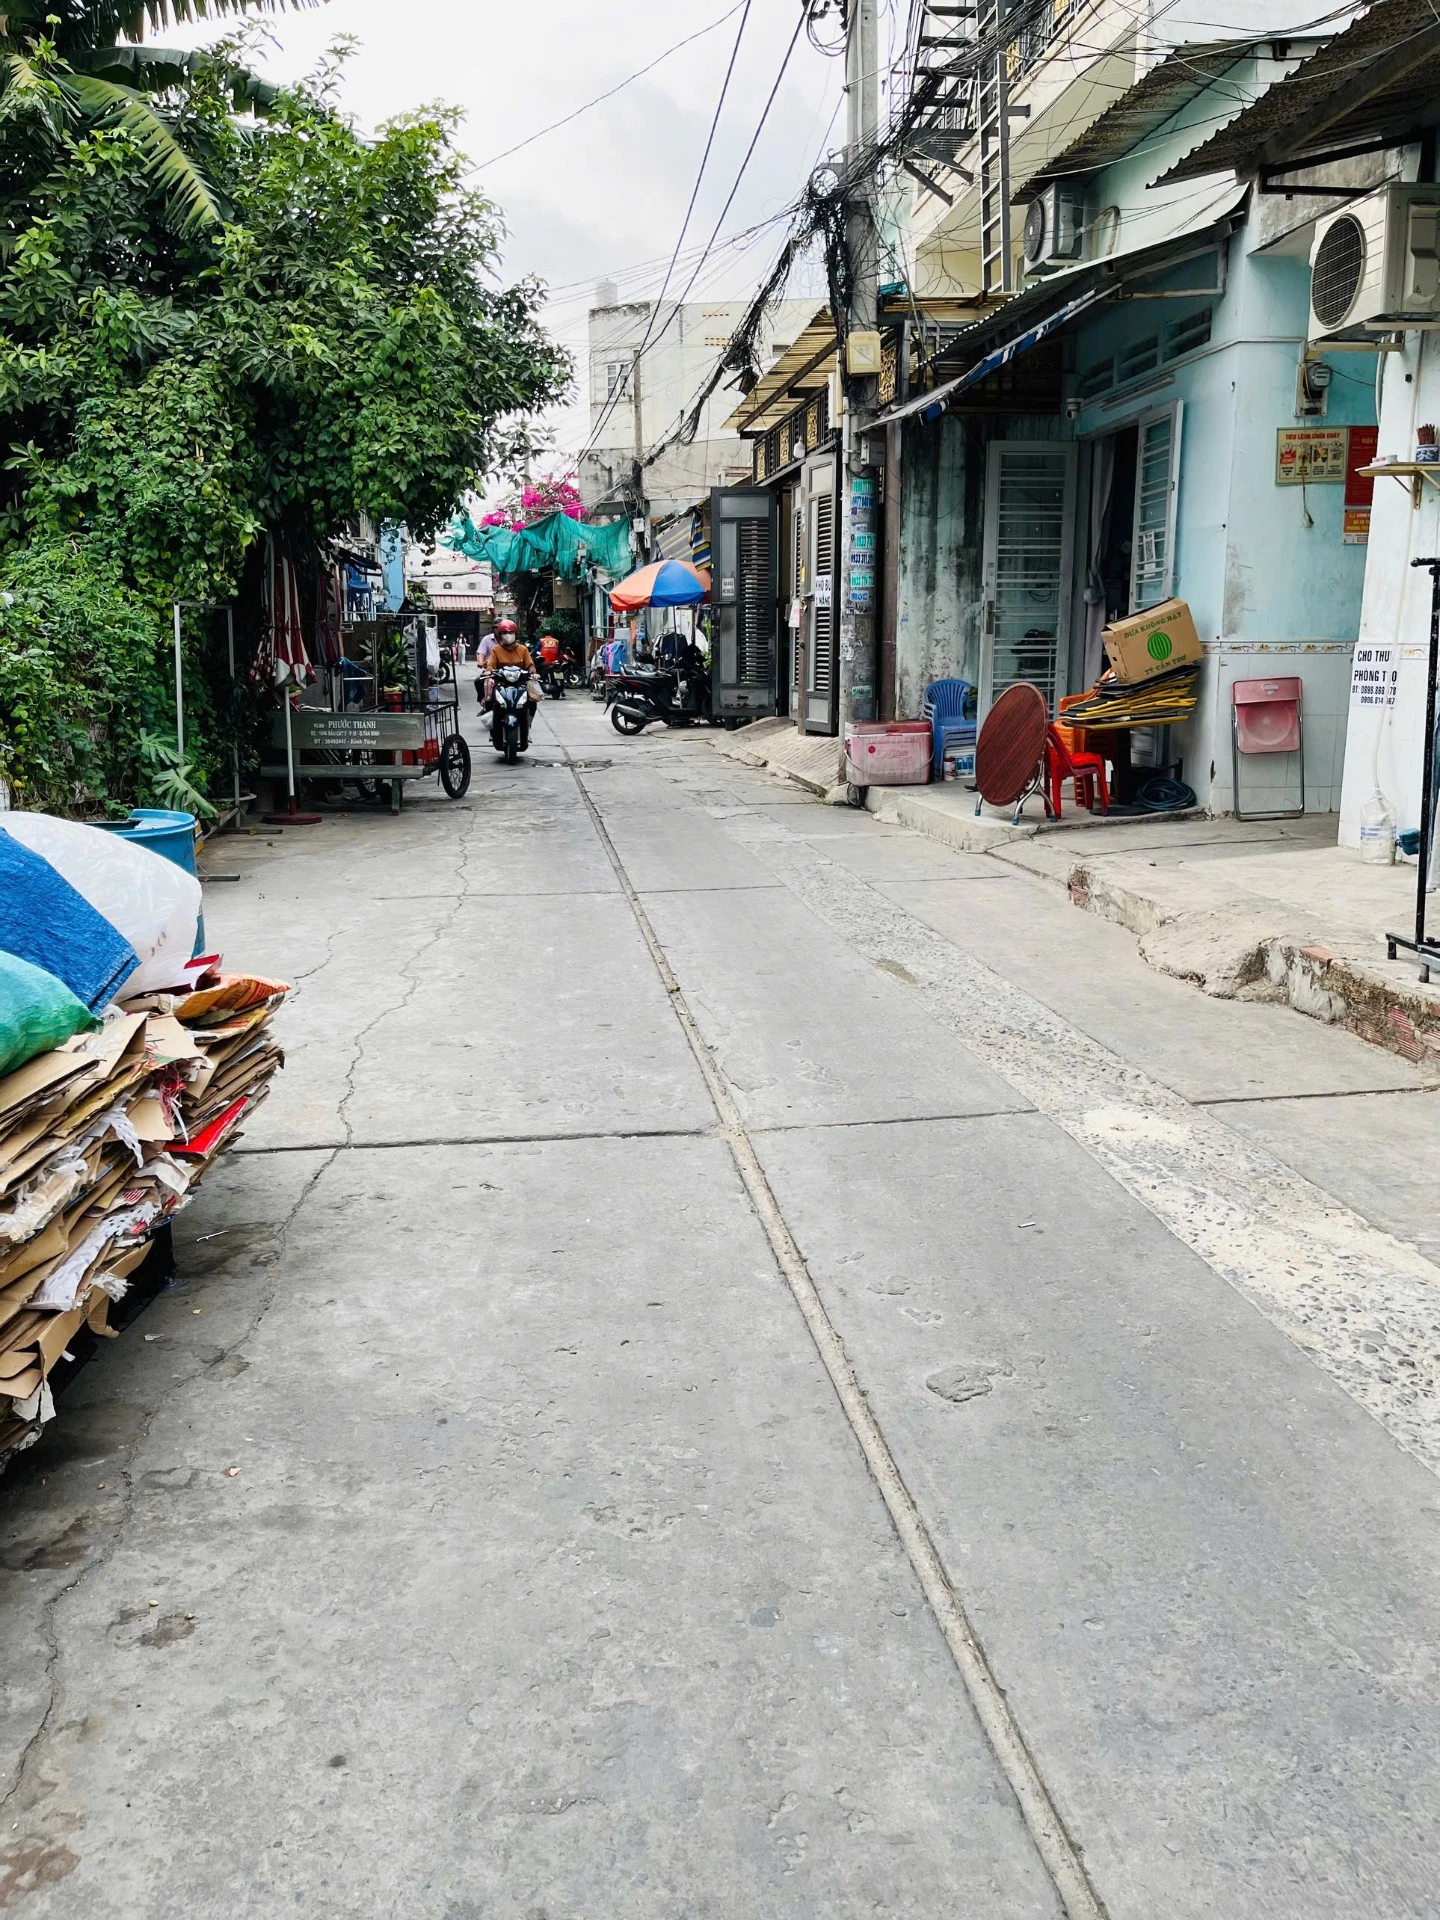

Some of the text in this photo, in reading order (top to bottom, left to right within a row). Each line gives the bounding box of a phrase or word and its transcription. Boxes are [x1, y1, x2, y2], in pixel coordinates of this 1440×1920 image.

[1124, 612, 1182, 639] DƯA KHÔNG HẠT
[1172, 654, 1186, 664] THƠ
[1358, 650, 1392, 662] CHO THU
[1354, 668, 1398, 685] PHÒNG TỌ
[328, 719, 351, 728] PHƯỚC
[353, 718, 376, 728] THÀNH
